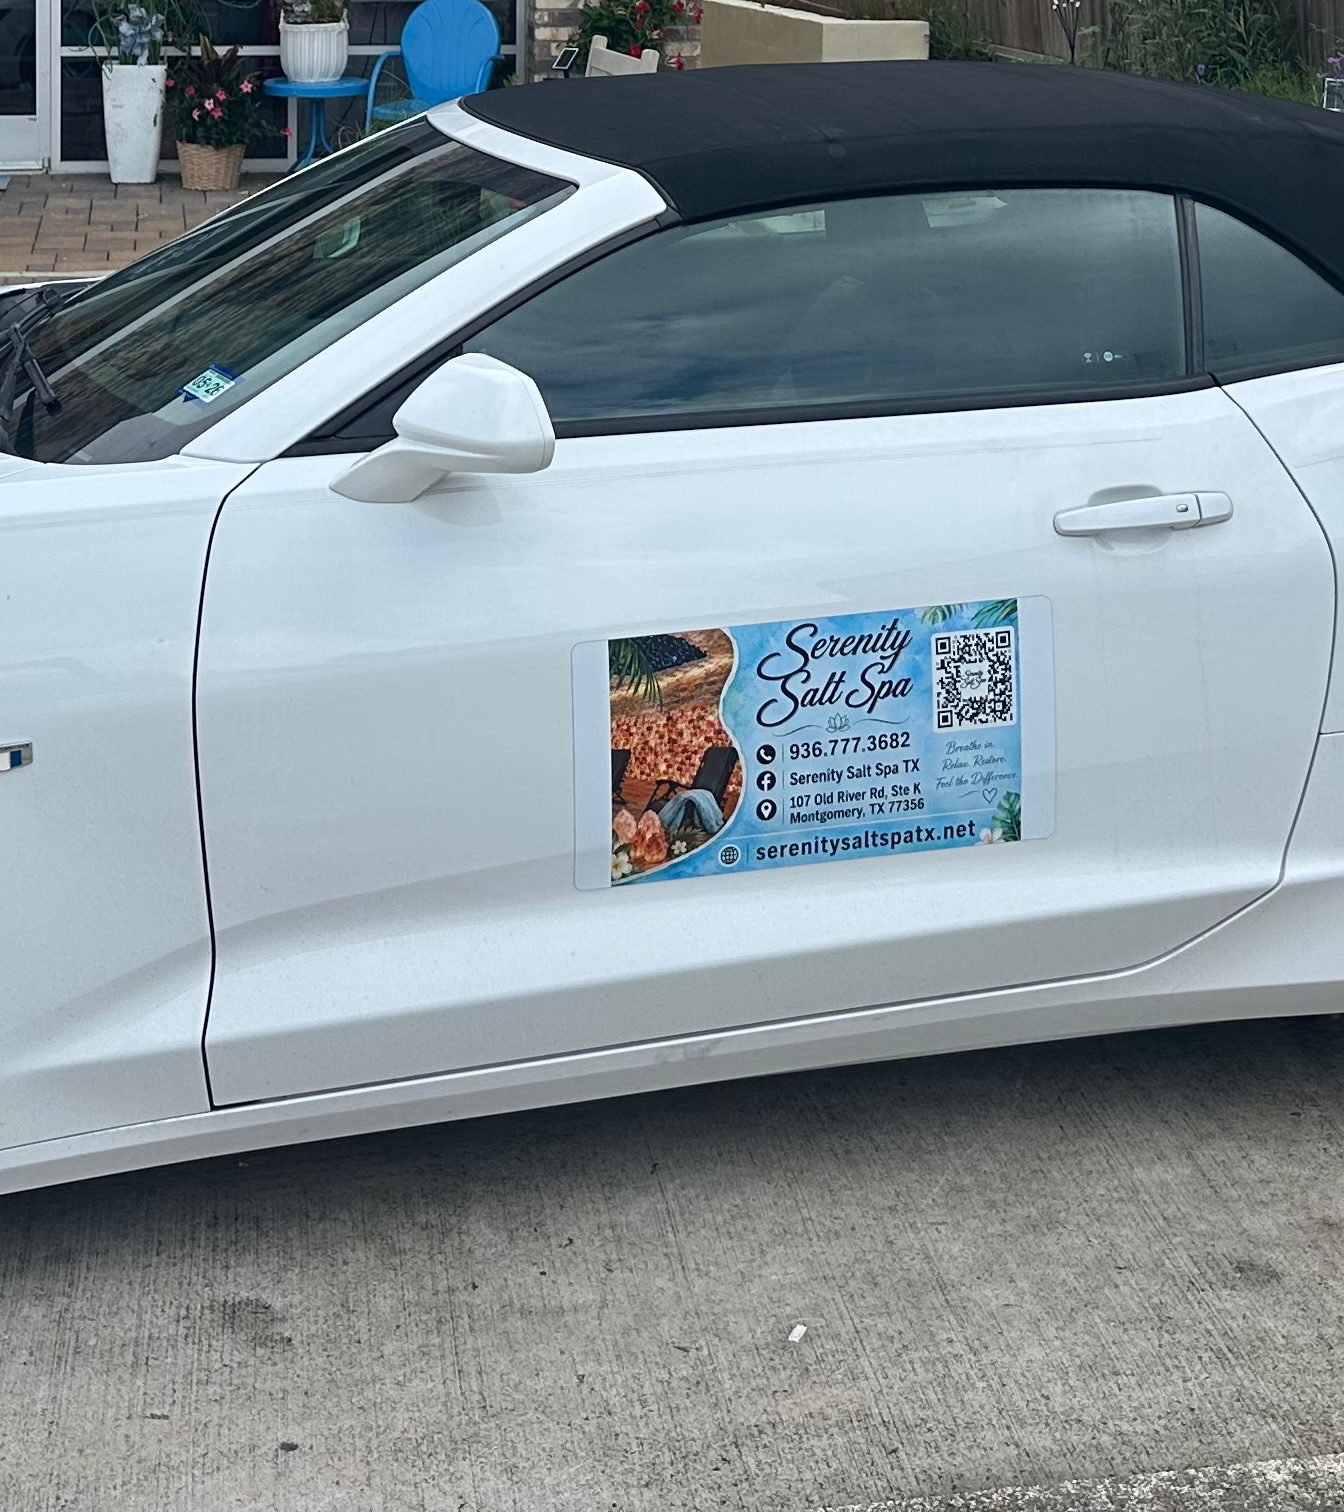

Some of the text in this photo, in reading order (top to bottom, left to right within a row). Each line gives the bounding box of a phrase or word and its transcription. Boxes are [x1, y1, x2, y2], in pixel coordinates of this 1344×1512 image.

[757, 618, 913, 680] Serenity
[756, 662, 914, 727] Salt Spa
[790, 731, 910, 760] 936.777.3682
[946, 739, 982, 755] Breathe
[790, 758, 920, 786] Serenity Salt Spa TX
[936, 777, 953, 790] Feel
[956, 775, 968, 787] the
[790, 782, 921, 809] 107 Old River Rd, Ste K
[790, 798, 924, 824] Montgomery, TX 77356
[756, 820, 975, 861] serenitysaltspatx.net
